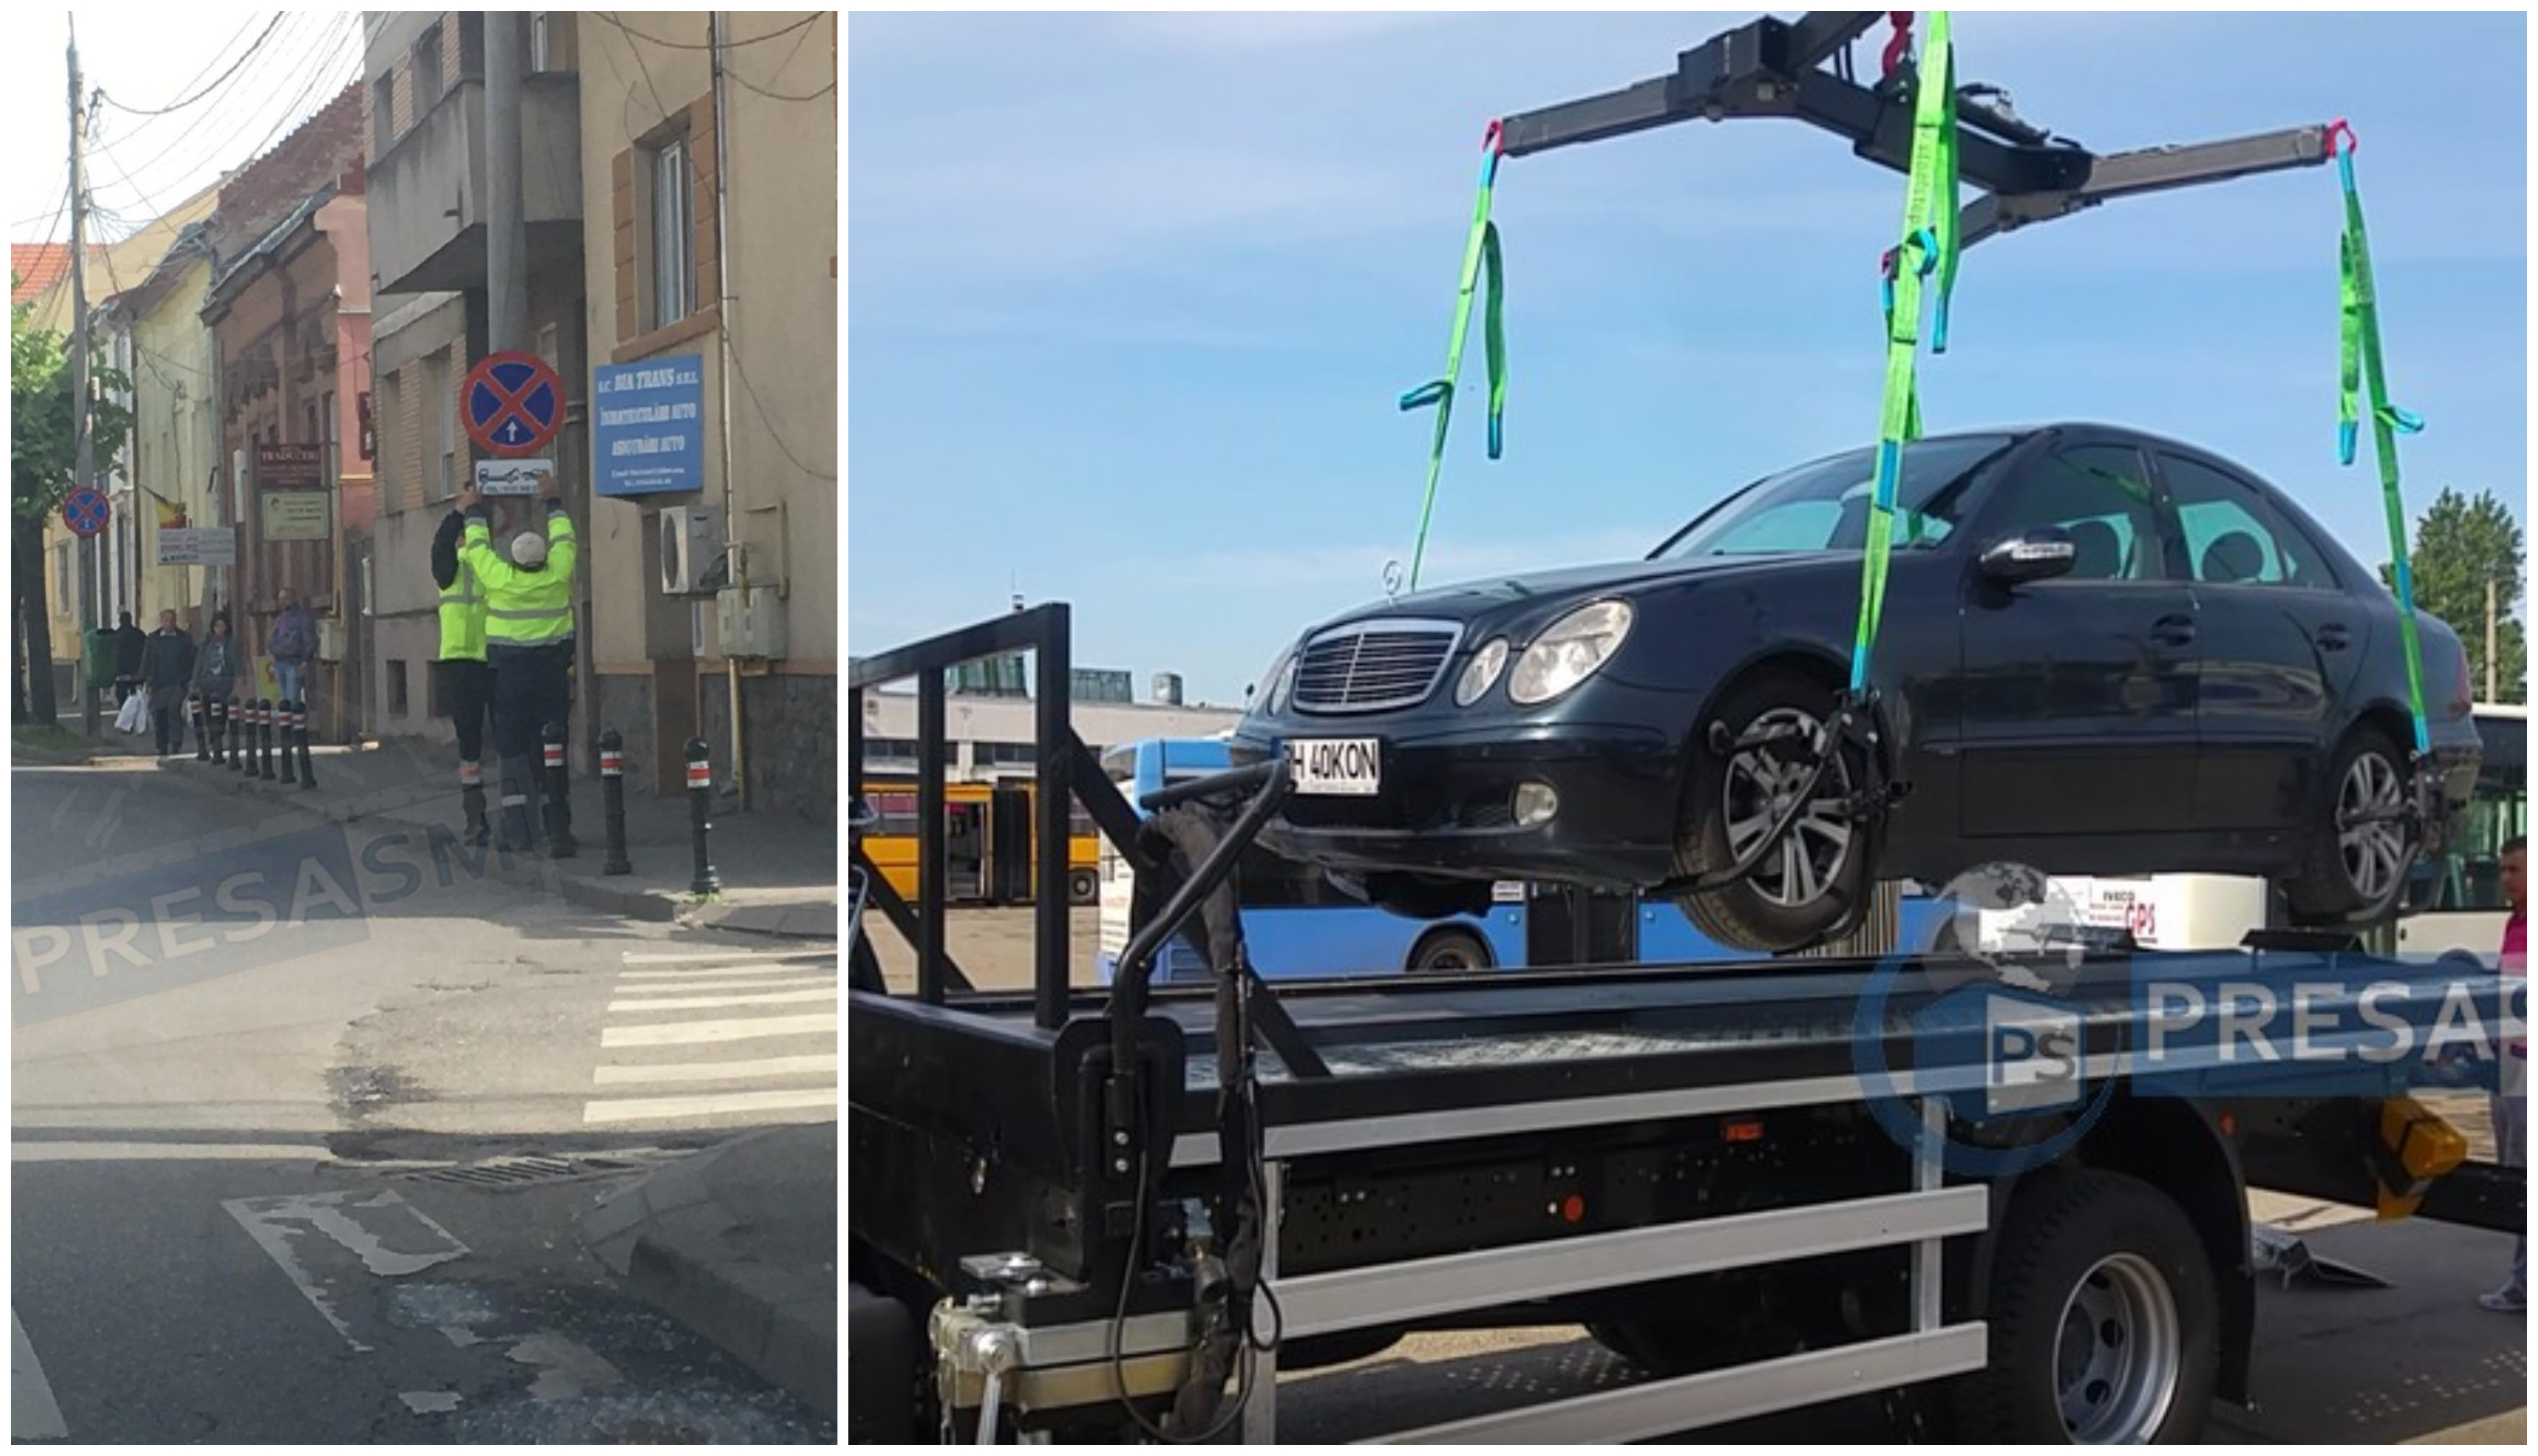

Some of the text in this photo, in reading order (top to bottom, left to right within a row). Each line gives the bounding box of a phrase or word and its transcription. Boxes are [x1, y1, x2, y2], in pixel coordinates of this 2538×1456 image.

[637, 368, 675, 389] TRANS
[672, 403, 697, 419] AUTO
[660, 436, 685, 452] AUTO
[2126, 902, 2155, 935] GPS
